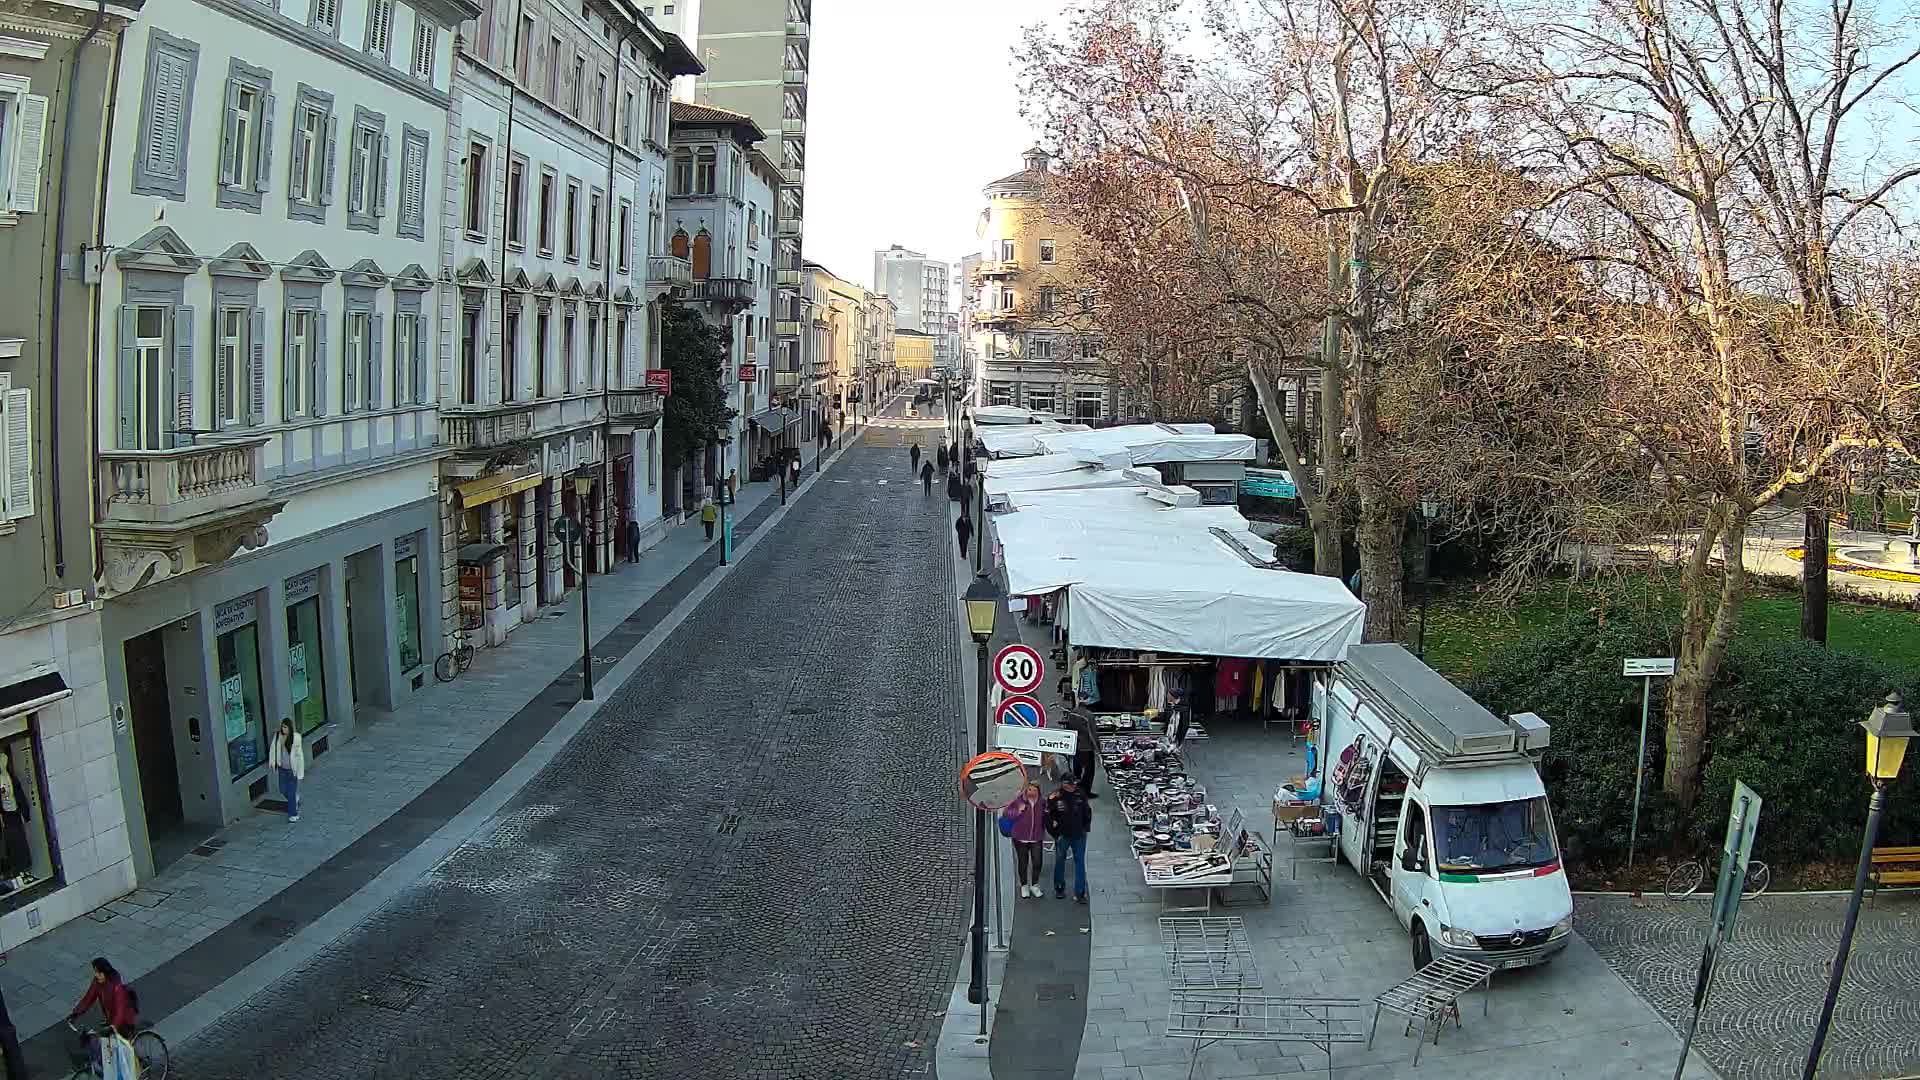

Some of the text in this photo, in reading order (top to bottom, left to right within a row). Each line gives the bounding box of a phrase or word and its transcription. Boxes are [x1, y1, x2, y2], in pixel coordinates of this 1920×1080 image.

[1006, 658, 1033, 681] 30
[223, 678, 241, 700] 130
[1039, 738, 1070, 749] Dante
